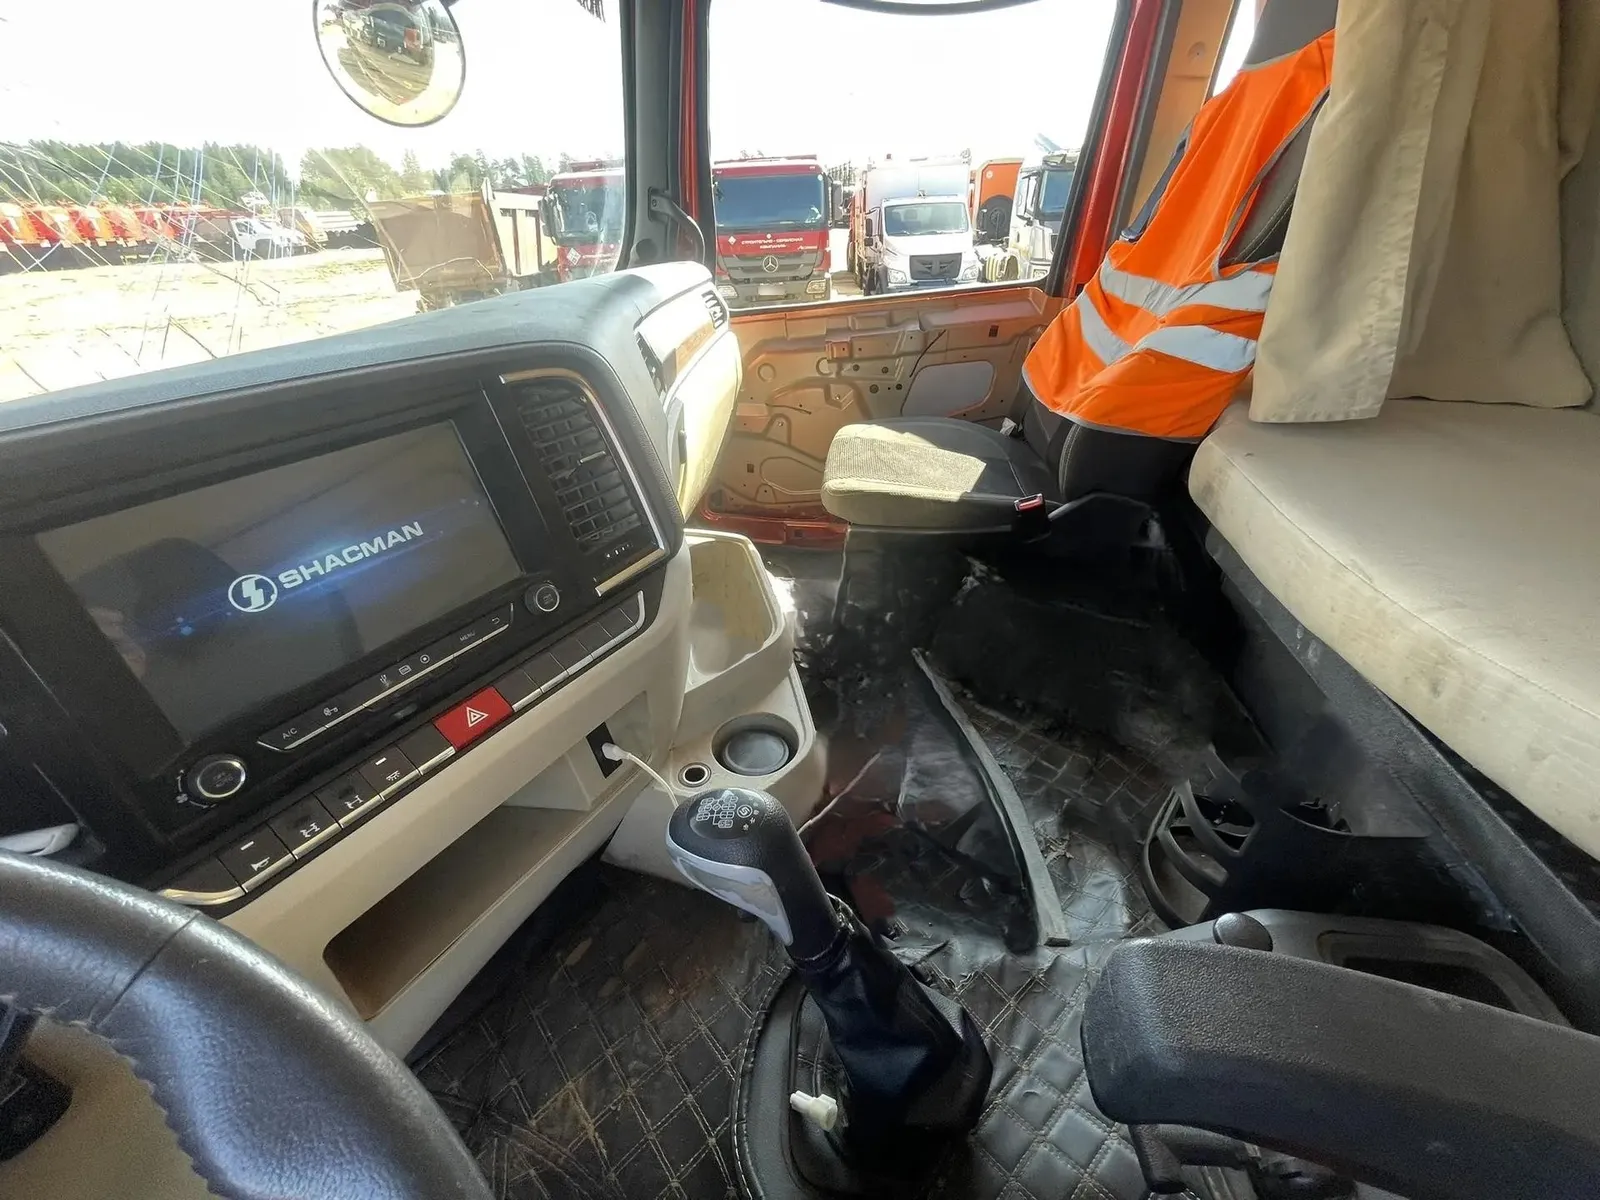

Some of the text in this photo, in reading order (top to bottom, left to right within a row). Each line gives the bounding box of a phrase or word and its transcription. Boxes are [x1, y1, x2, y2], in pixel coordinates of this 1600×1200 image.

[278, 521, 424, 589] SHACMAN
[459, 631, 476, 642] MENU
[282, 727, 298, 739] A/C
